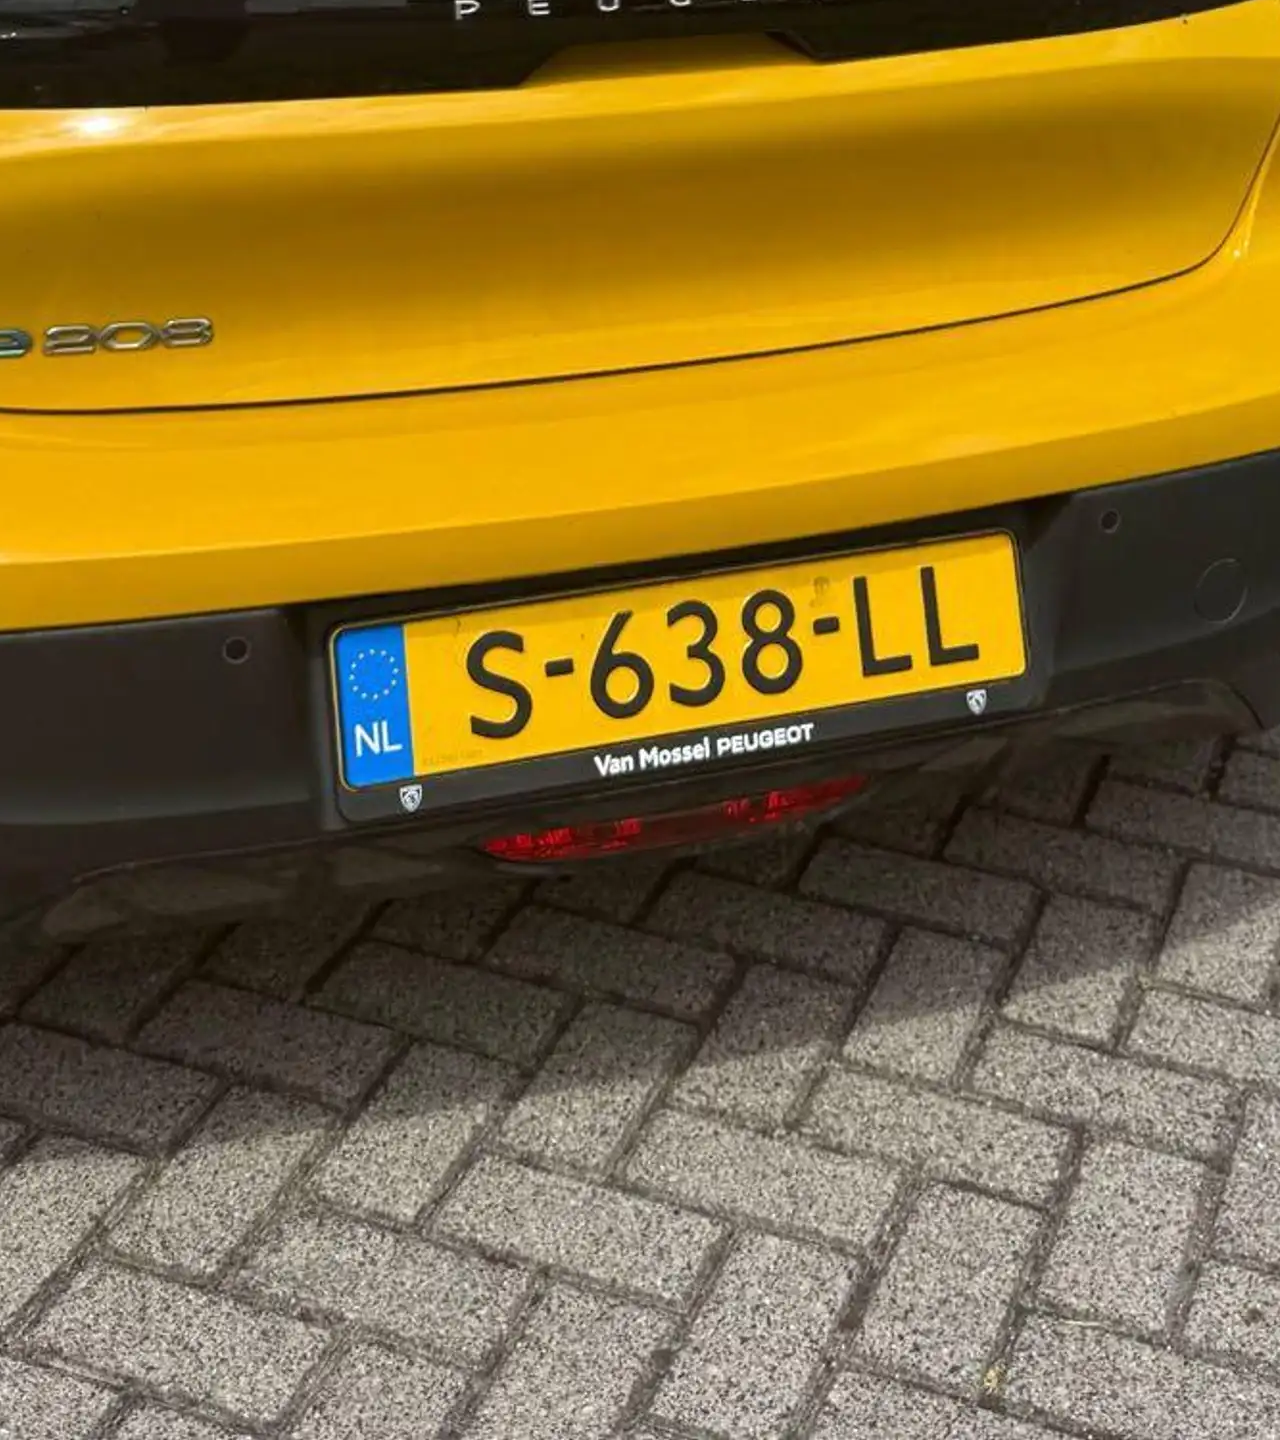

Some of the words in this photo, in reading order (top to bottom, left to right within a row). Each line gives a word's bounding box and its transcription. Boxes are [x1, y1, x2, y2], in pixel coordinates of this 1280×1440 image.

[464, 565, 980, 739] S-638-LL
[353, 719, 403, 758] NL
[593, 753, 634, 777] Van
[638, 736, 711, 770] Mossel
[716, 722, 815, 756] PEUGEOT
